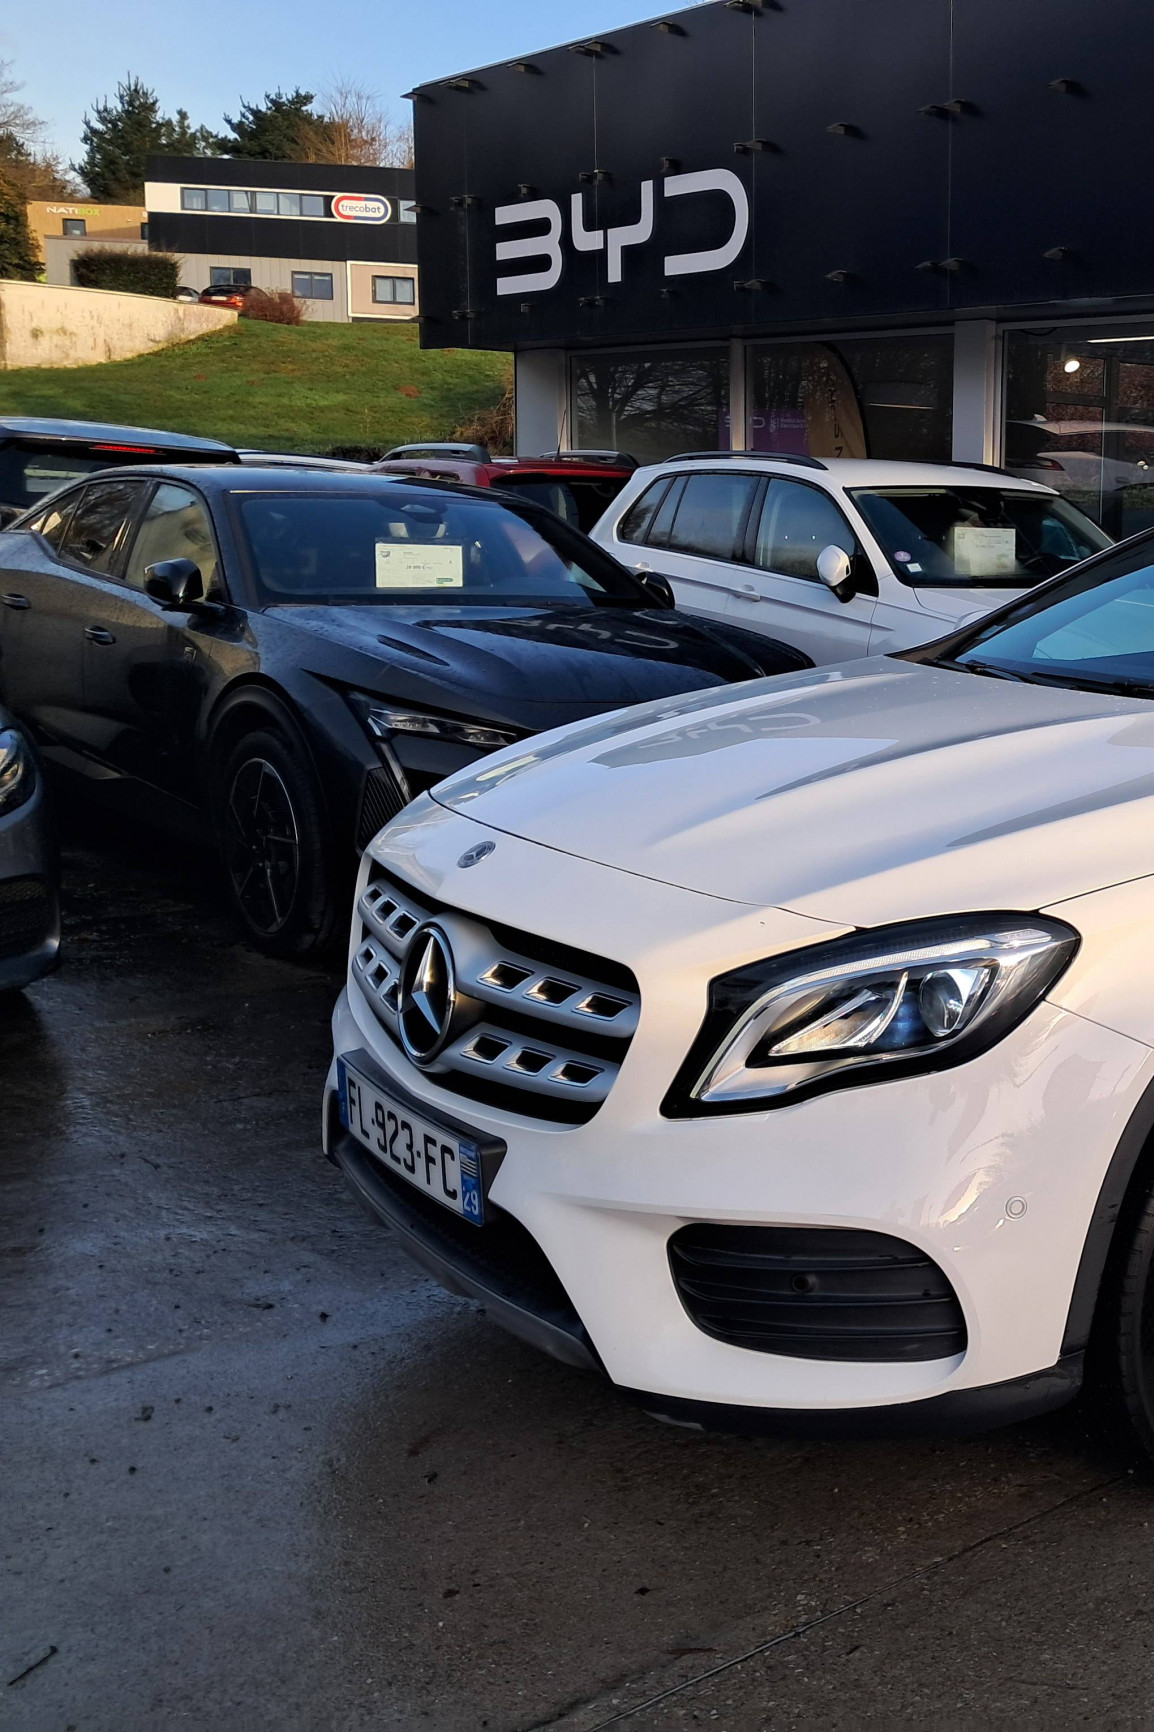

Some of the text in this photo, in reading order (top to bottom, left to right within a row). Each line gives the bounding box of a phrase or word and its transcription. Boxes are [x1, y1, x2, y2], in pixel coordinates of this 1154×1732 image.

[341, 203, 381, 214] trecobat
[495, 168, 749, 296] BYD
[347, 1076, 459, 1201] FL-923-FC
[463, 1186, 479, 1216] 29
